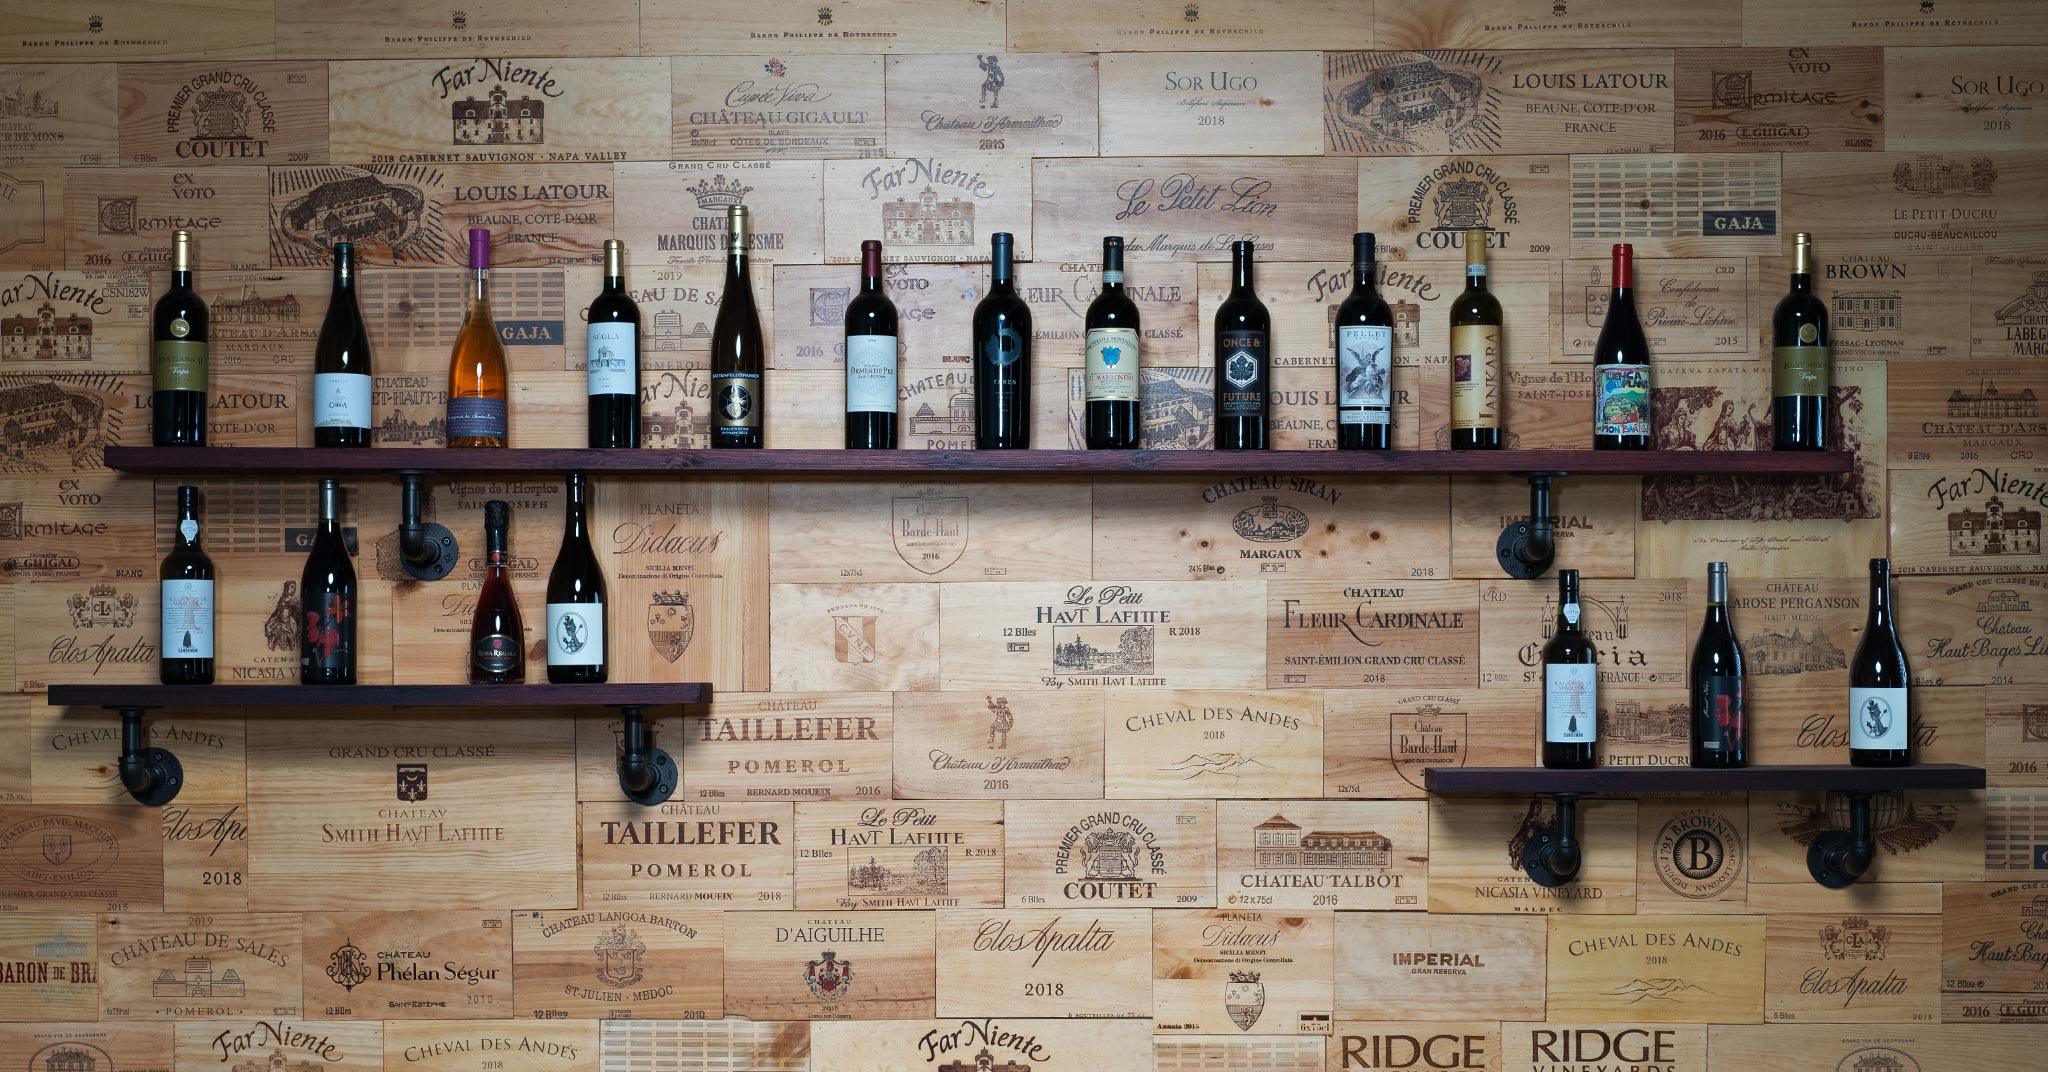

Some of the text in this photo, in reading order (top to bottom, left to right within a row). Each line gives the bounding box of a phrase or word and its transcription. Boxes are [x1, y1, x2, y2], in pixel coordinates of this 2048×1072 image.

[1787, 61, 1831, 74] VOTO
[432, 57, 565, 99] Far Niente
[1165, 71, 1258, 91] SOR UGO
[1511, 73, 1669, 89] LOUIS LATOUR
[166, 70, 278, 134] PREMIER GRAND CRU CLASSÉ
[690, 107, 869, 126] CHÂTEAU GIGAULT
[1197, 115, 1225, 127] 2018
[1563, 122, 1616, 132] FRANCE
[175, 139, 269, 158] COUTET
[729, 136, 829, 147] CÔTES DE BORDEAUX
[978, 138, 1005, 151] 2015
[287, 152, 309, 162] 2009
[372, 150, 627, 163] 2018 CABERNET SAUVIGNON NAPA VALLEY
[862, 157, 995, 200] Far Niente
[172, 187, 215, 200] VOTO
[454, 184, 610, 201] LOUIS LATOUR
[1115, 172, 1278, 221] Le Petit Lion
[1894, 208, 1998, 220] LE PETIT DUCRU
[1715, 216, 1765, 230] GAJA
[1416, 230, 1511, 250] COUET
[1529, 245, 1551, 254] 2009
[85, 254, 112, 266] 2016
[657, 270, 683, 281] 2019
[1716, 265, 1736, 274] CRD
[1826, 263, 1907, 279] BROWN
[1306, 267, 1353, 303] Far
[21, 272, 112, 314] Niente
[502, 325, 553, 341] GAJA
[1145, 328, 1183, 339] CLASSÉ
[1716, 336, 1739, 346] 2015
[797, 345, 823, 358] 2016
[1274, 356, 1335, 366] CABERNET
[1223, 392, 1262, 402] FUTURE
[1201, 475, 1343, 506] CHATEAU SIRAN
[1928, 476, 1972, 511] Far
[57, 493, 101, 506] VOTO
[640, 502, 700, 516] PLANETA
[1239, 549, 1302, 559] MARGAUX
[1410, 567, 1434, 577] 2018
[1919, 564, 2022, 575] CABERNET SAUVIGNON
[1098, 584, 1144, 606] Petit
[1342, 587, 1404, 599] CHATEAU
[1783, 597, 1861, 609] PERGANSON
[1168, 626, 1201, 637] R 2018
[1363, 655, 1405, 666] GRAND
[1407, 655, 1425, 666] CRU
[1427, 653, 1466, 667] CLASSÉ
[232, 666, 286, 680] NICASIA
[1363, 673, 1386, 684] 2018
[758, 699, 818, 713] CHÂTEAU
[1125, 706, 1302, 734] CHEVAL DES ANDES
[698, 716, 880, 742] TAILLEFER
[1203, 731, 1226, 741] 2018
[328, 743, 496, 761] GRAND CRU CLASSÉ
[728, 759, 851, 775] POMEROL
[1607, 754, 1643, 766] PETIT
[2009, 761, 2038, 773] 2016
[983, 778, 1009, 791] 2016
[1078, 811, 1146, 838] GRAND CRU
[601, 820, 782, 847] TAILLEFER
[630, 863, 752, 879] POMEROL
[202, 870, 242, 887] 2018
[1241, 873, 1404, 889] CHATEAU TALBOT
[758, 891, 782, 902] 2018
[1063, 881, 1157, 900] COUTET
[1474, 885, 1603, 899] NICASIA VINEYARD
[1176, 894, 1198, 903] 2009
[1312, 894, 1340, 906] 2016
[542, 911, 698, 940] CHATEAU LANGOA BARTON
[776, 928, 885, 943] D'AIGUILHE
[109, 930, 290, 970] CHÂTEAU DE SALES
[1568, 931, 1744, 958] CHEVAL DES ANDES
[1392, 951, 1485, 968] IMPERIAL
[1646, 955, 1668, 965] 2018
[378, 959, 502, 987] Phélan Ségur
[1411, 967, 1467, 977] GRAN RESERVA
[1025, 982, 1065, 997] 2018
[164, 1006, 234, 1018] POMEROL
[1961, 1005, 1991, 1018] 2016
[212, 1020, 344, 1063] Far Niente
[918, 1019, 1051, 1063] Far Niente
[1531, 1028, 1677, 1063] RIDGE
[404, 1036, 579, 1063] CHEVAL DES ANDES
[1341, 1034, 1486, 1070] RIDGE
[482, 1060, 504, 1071] 2018
